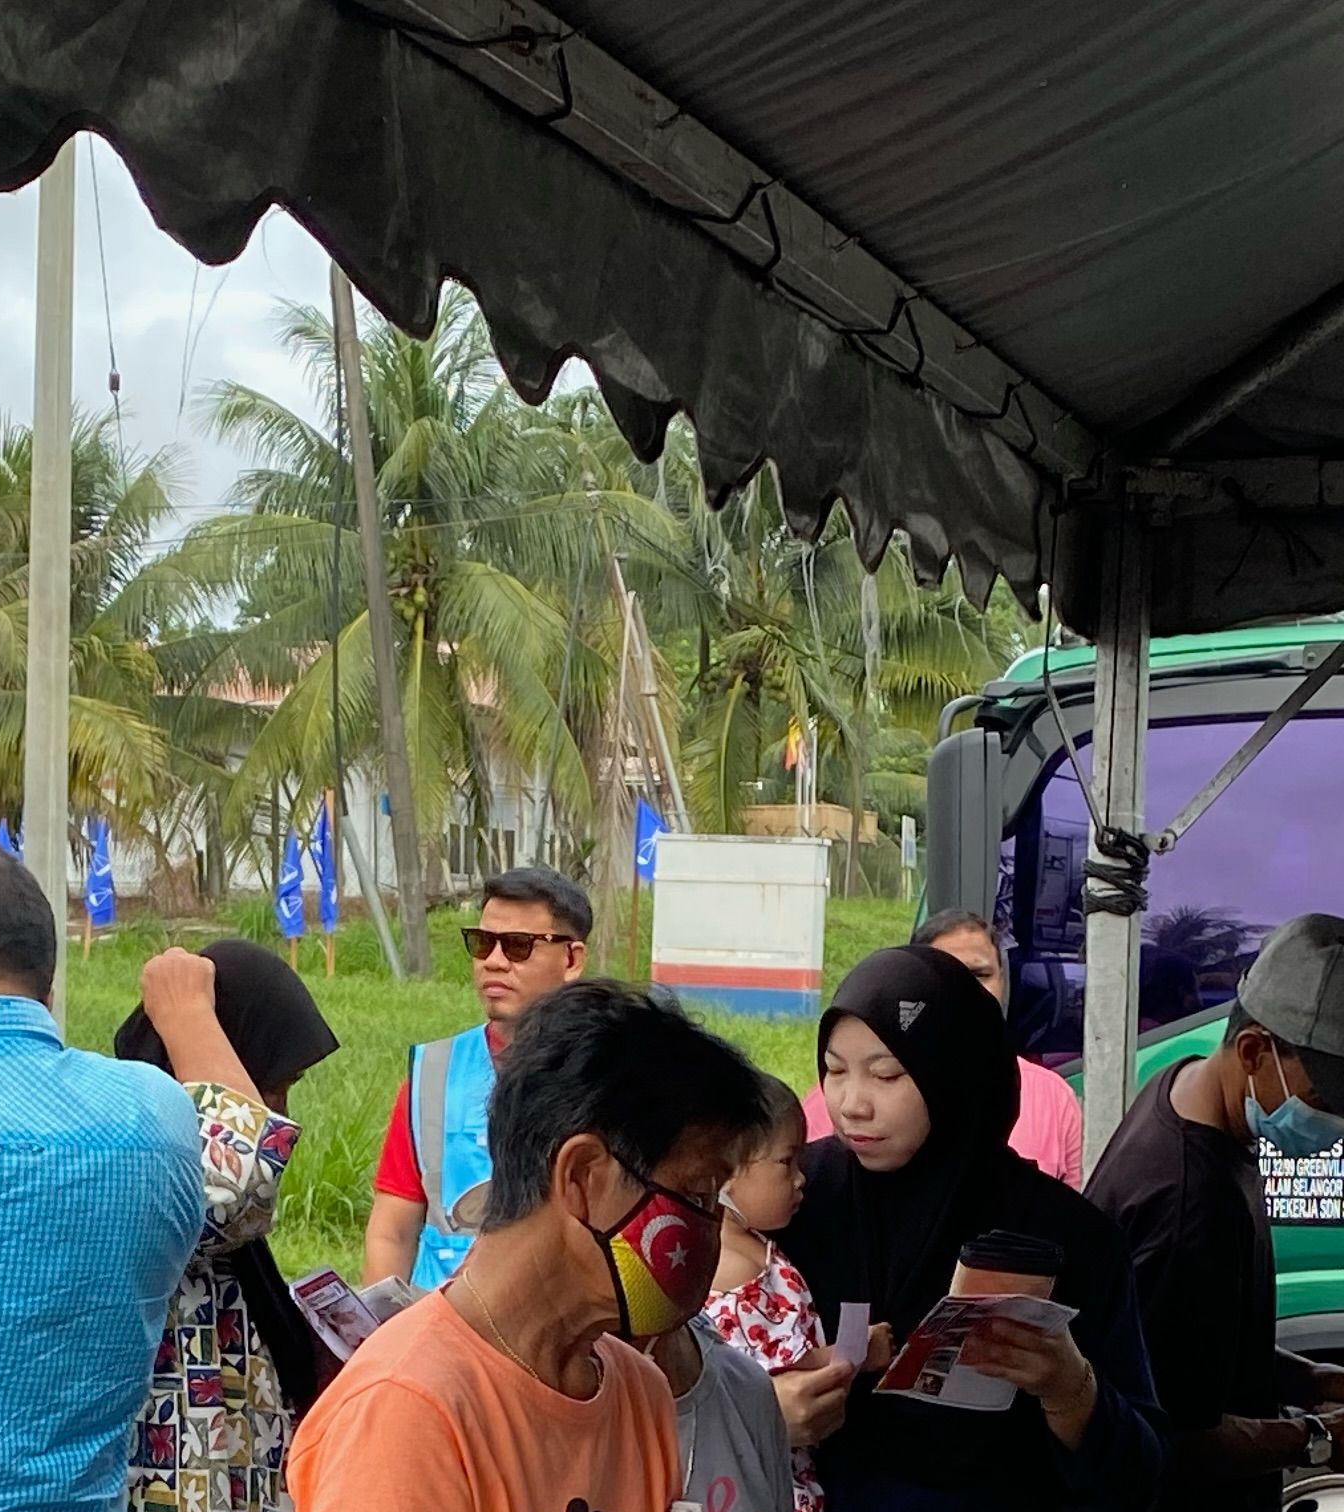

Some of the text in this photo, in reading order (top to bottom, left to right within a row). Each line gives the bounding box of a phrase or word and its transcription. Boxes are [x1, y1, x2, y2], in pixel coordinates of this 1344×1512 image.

[1264, 1178, 1291, 1196] ALAM
[1292, 1178, 1343, 1196] SELANGOR
[1273, 1198, 1319, 1218] PEKERJA
